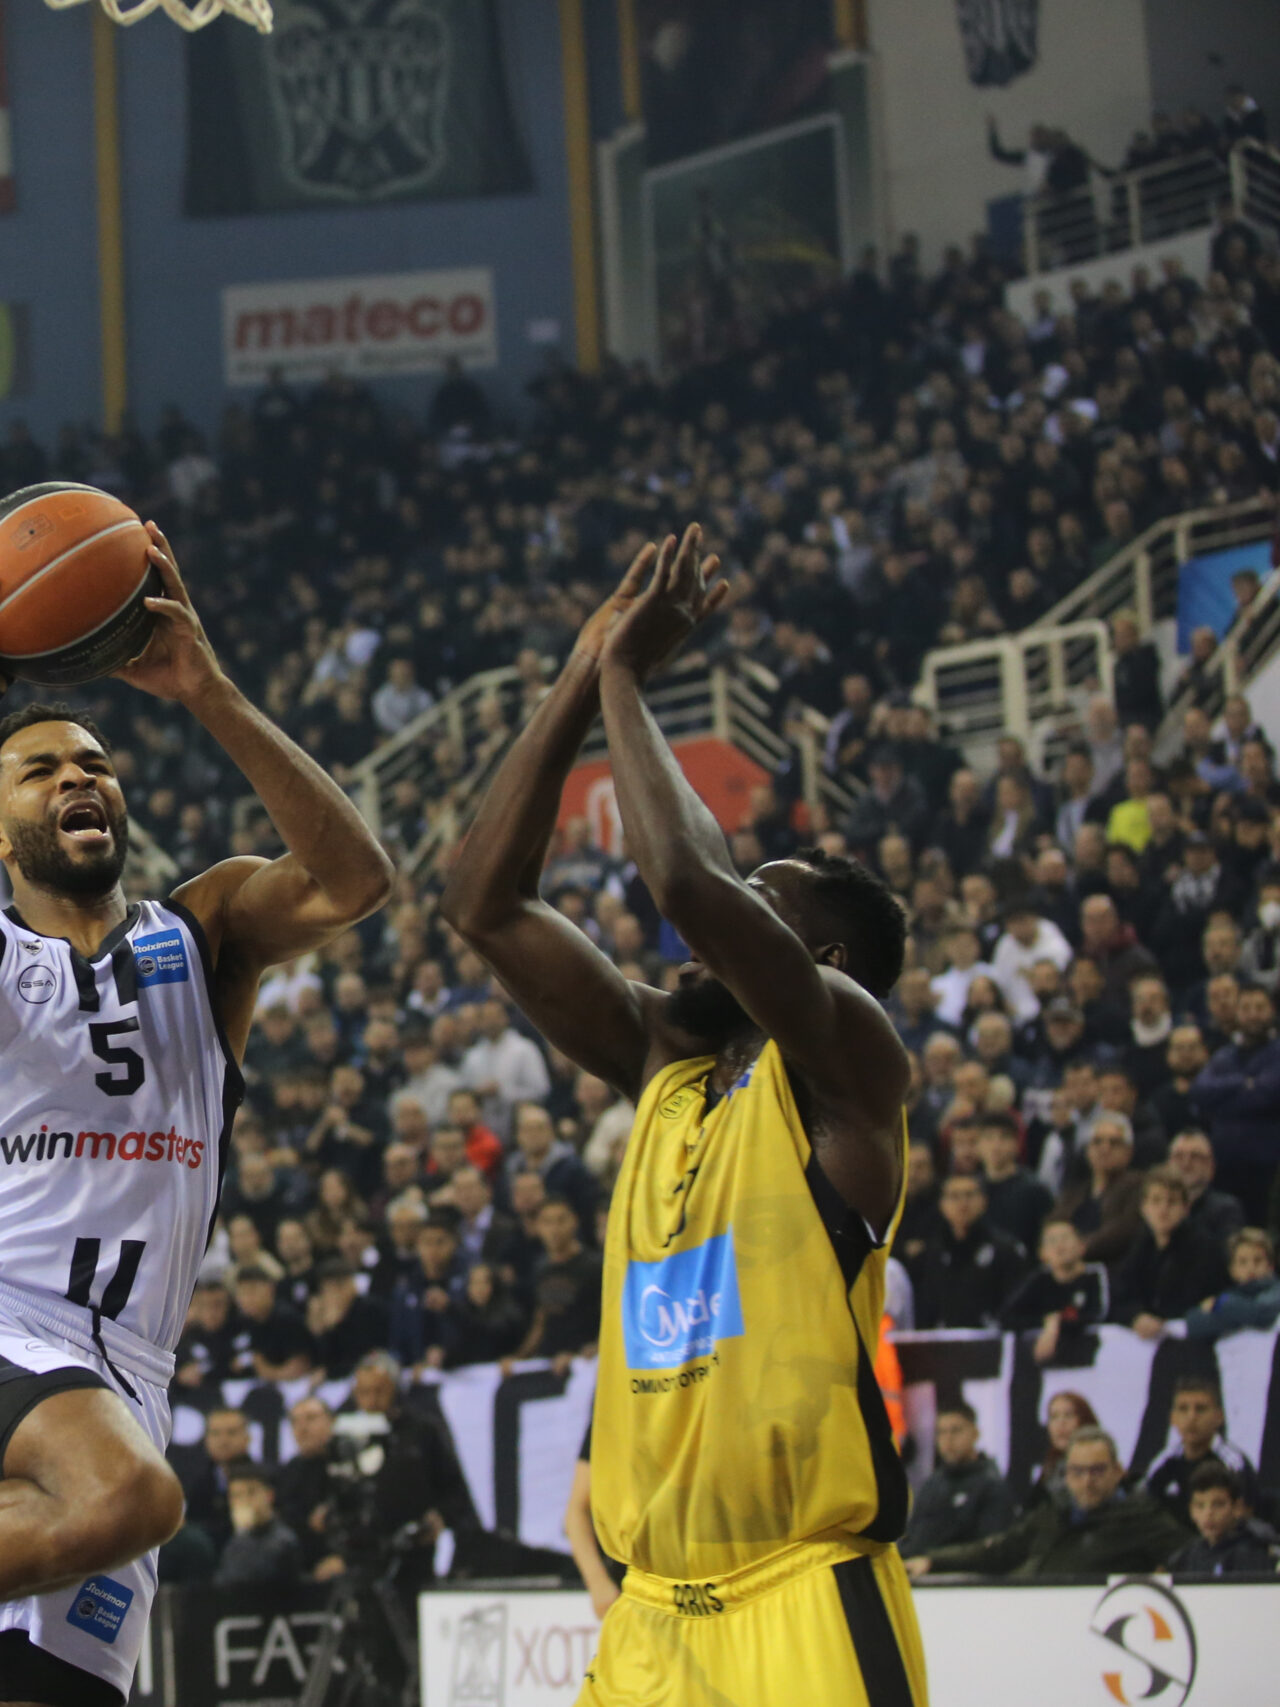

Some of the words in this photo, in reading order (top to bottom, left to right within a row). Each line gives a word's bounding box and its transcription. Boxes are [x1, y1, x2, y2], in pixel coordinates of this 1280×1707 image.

[235, 291, 485, 349] mateco
[157, 953, 183, 963] Basket
[159, 962, 185, 971] League
[88, 1016, 145, 1096] 5
[0, 1124, 204, 1169] winmasters
[85, 1582, 127, 1609] Stoiximan
[673, 1582, 724, 1616] ARIS
